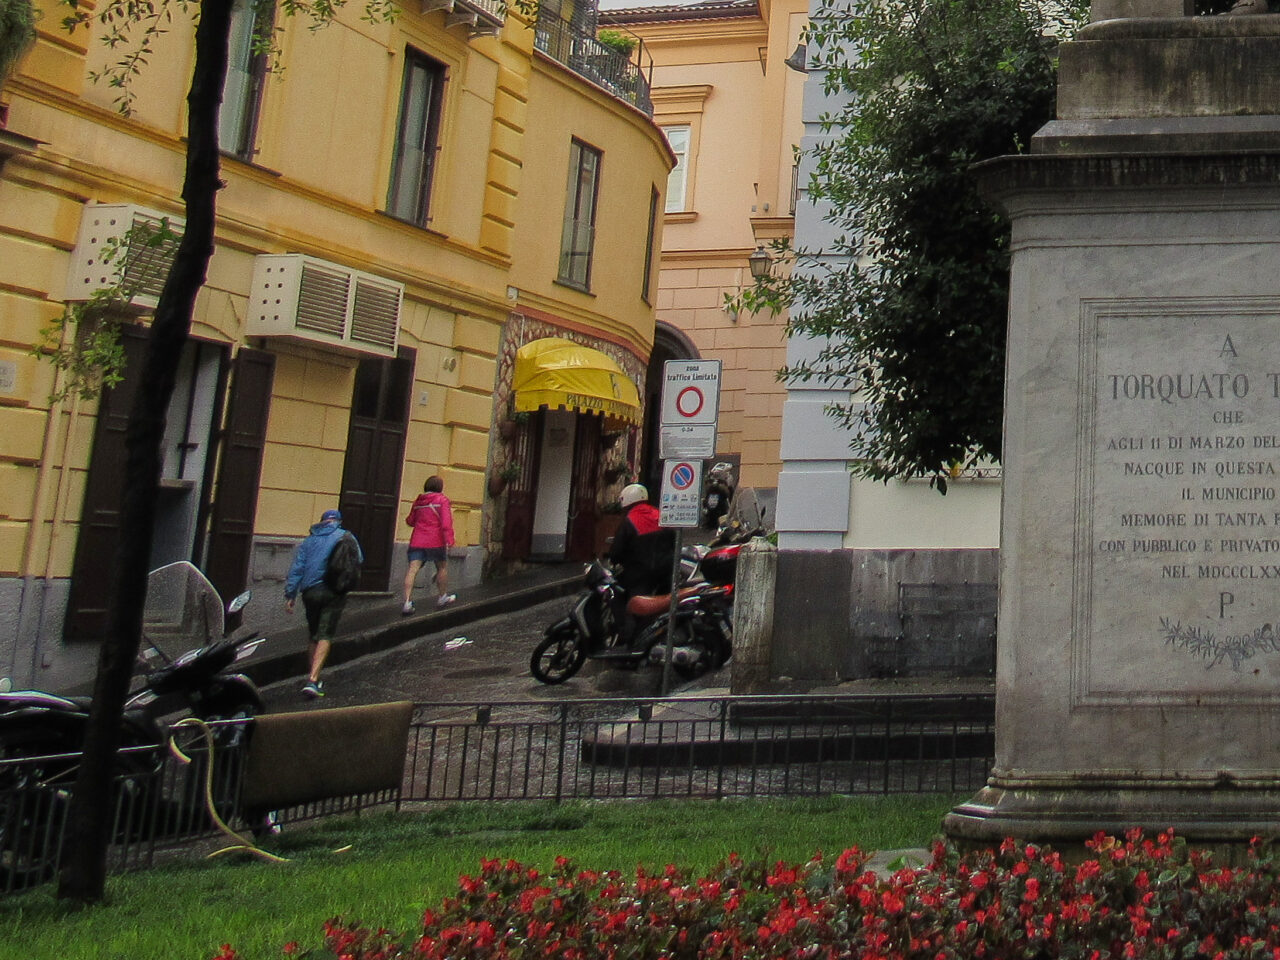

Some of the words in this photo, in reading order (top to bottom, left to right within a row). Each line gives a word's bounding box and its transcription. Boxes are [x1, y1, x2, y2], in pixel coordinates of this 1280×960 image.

[1219, 333, 1238, 358] A
[1107, 373, 1249, 404] TORQUATO
[1213, 411, 1244, 424] CHE
[1107, 437, 1144, 451] AGLI
[1168, 436, 1182, 450] DI
[1189, 435, 1245, 450] MARZO
[1253, 435, 1280, 449] DEL
[1124, 461, 1184, 478] NACQUE
[1192, 461, 1207, 475] IN
[1215, 461, 1275, 478] QUESTA
[1181, 487, 1195, 500] IL
[1202, 487, 1276, 500] MUNICIPIO
[1121, 513, 1187, 527] MEMORE
[1194, 513, 1209, 526] DI
[1215, 512, 1267, 526] TANTA
[1099, 540, 1125, 552] CON
[1133, 539, 1197, 552] PUBBLICO
[1204, 539, 1213, 552] E
[1220, 539, 1280, 553] PRIVATO
[1162, 565, 1190, 578] NEL
